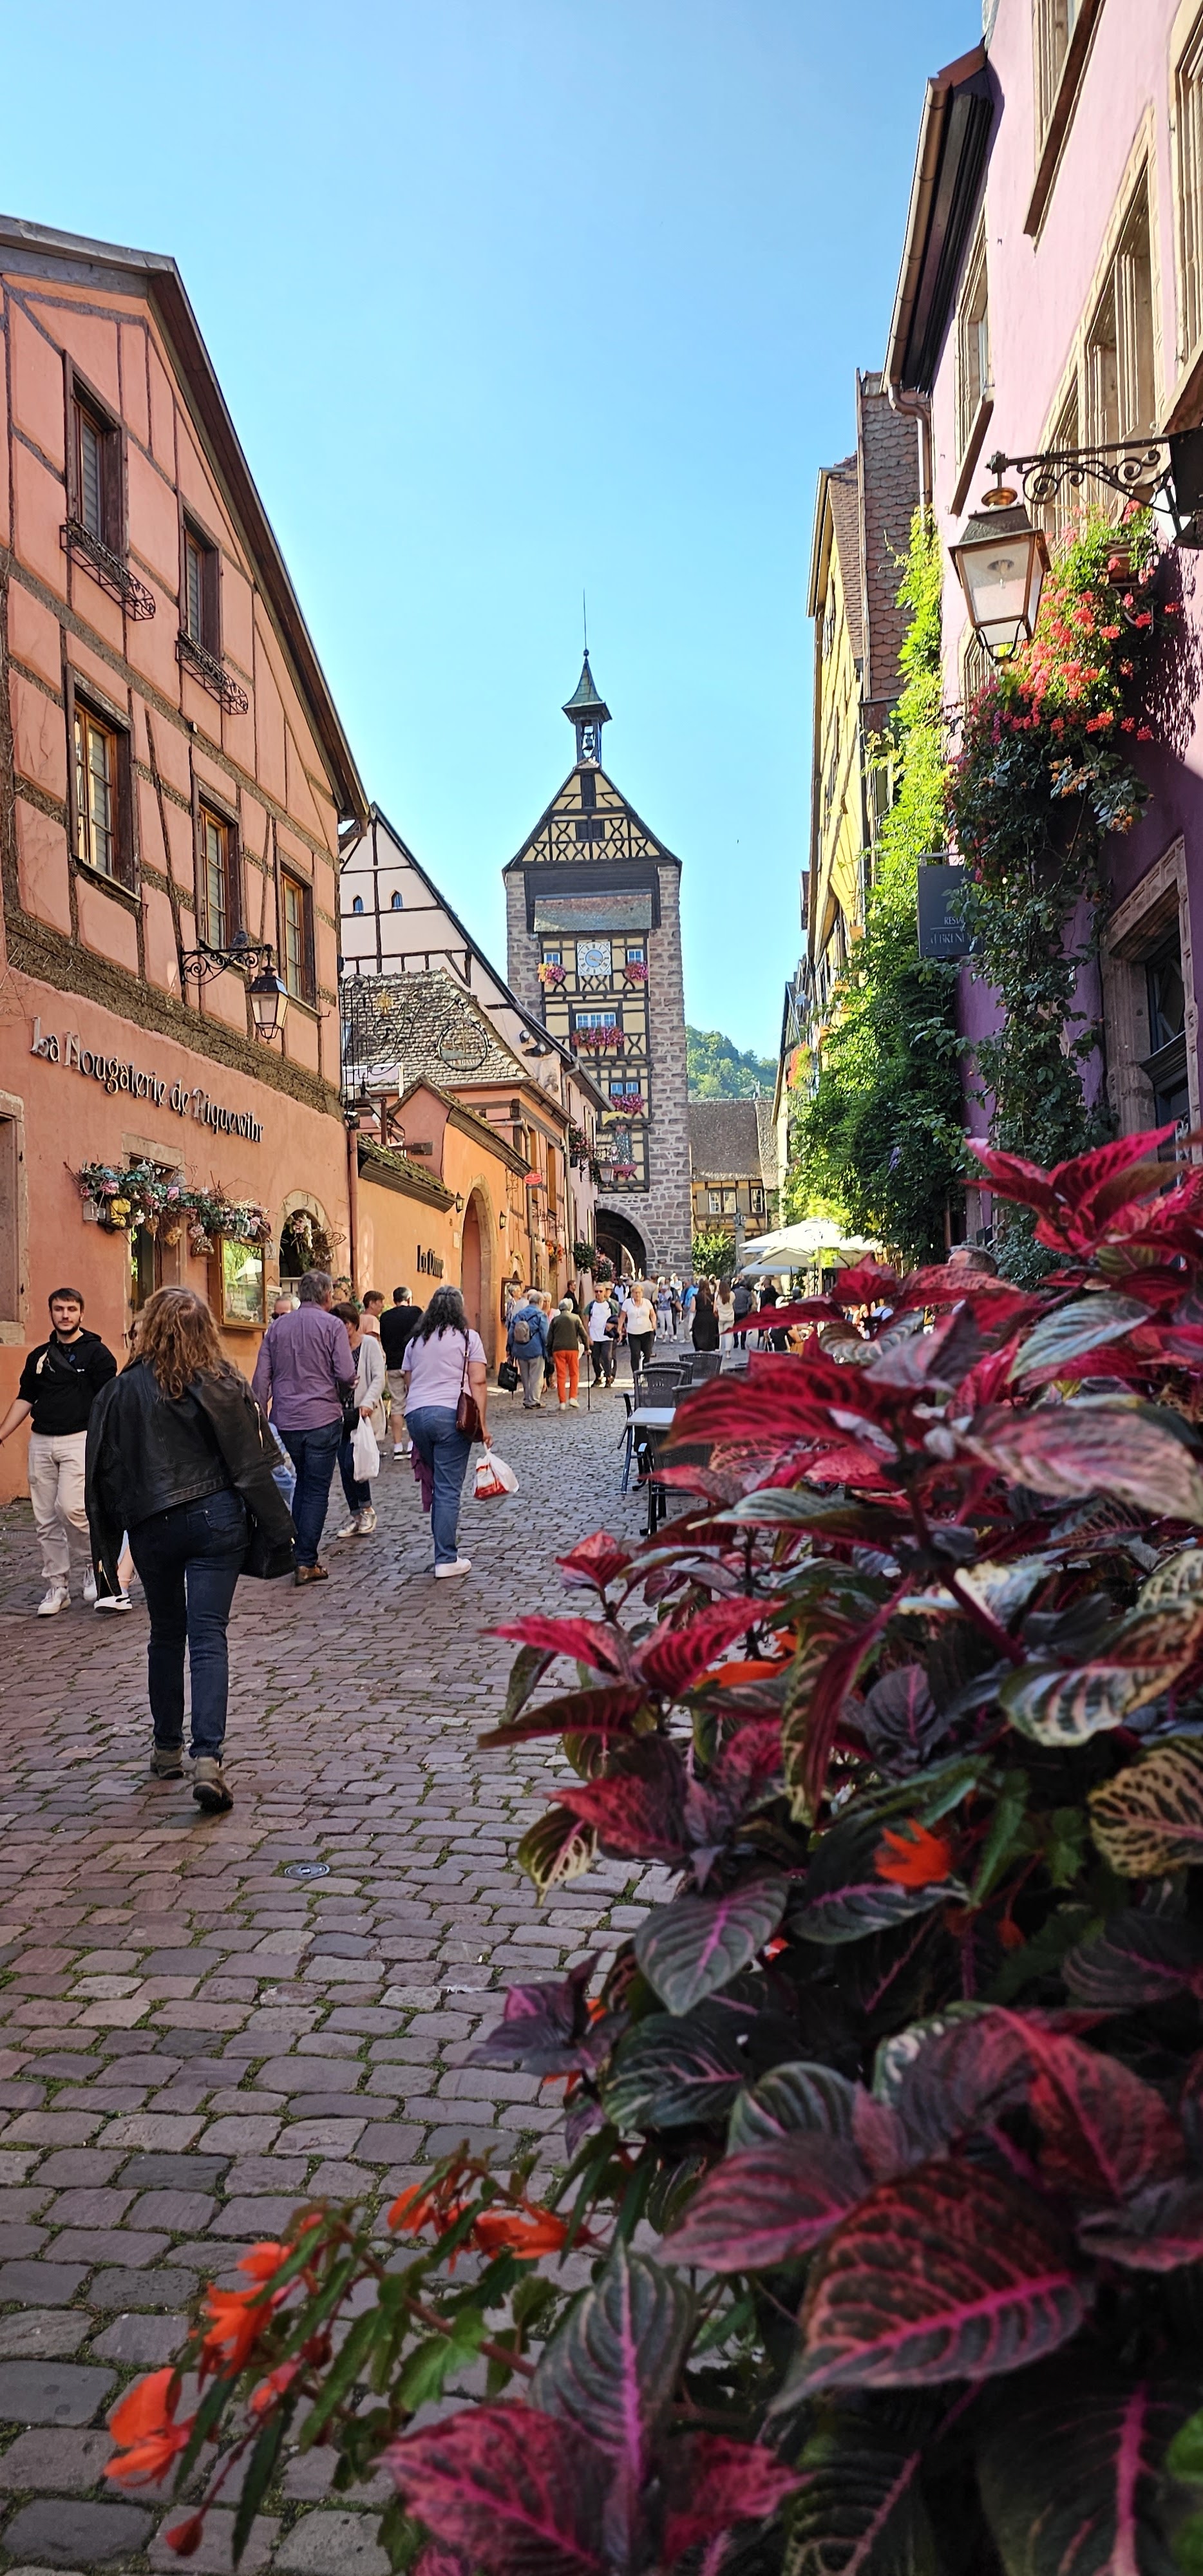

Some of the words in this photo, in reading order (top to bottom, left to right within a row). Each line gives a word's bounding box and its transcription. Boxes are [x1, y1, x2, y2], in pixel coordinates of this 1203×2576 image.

[30, 1016, 60, 1063] La
[63, 1031, 167, 1107] Nougaterie
[168, 1077, 191, 1117] de
[191, 1087, 264, 1143] Riquewihr
